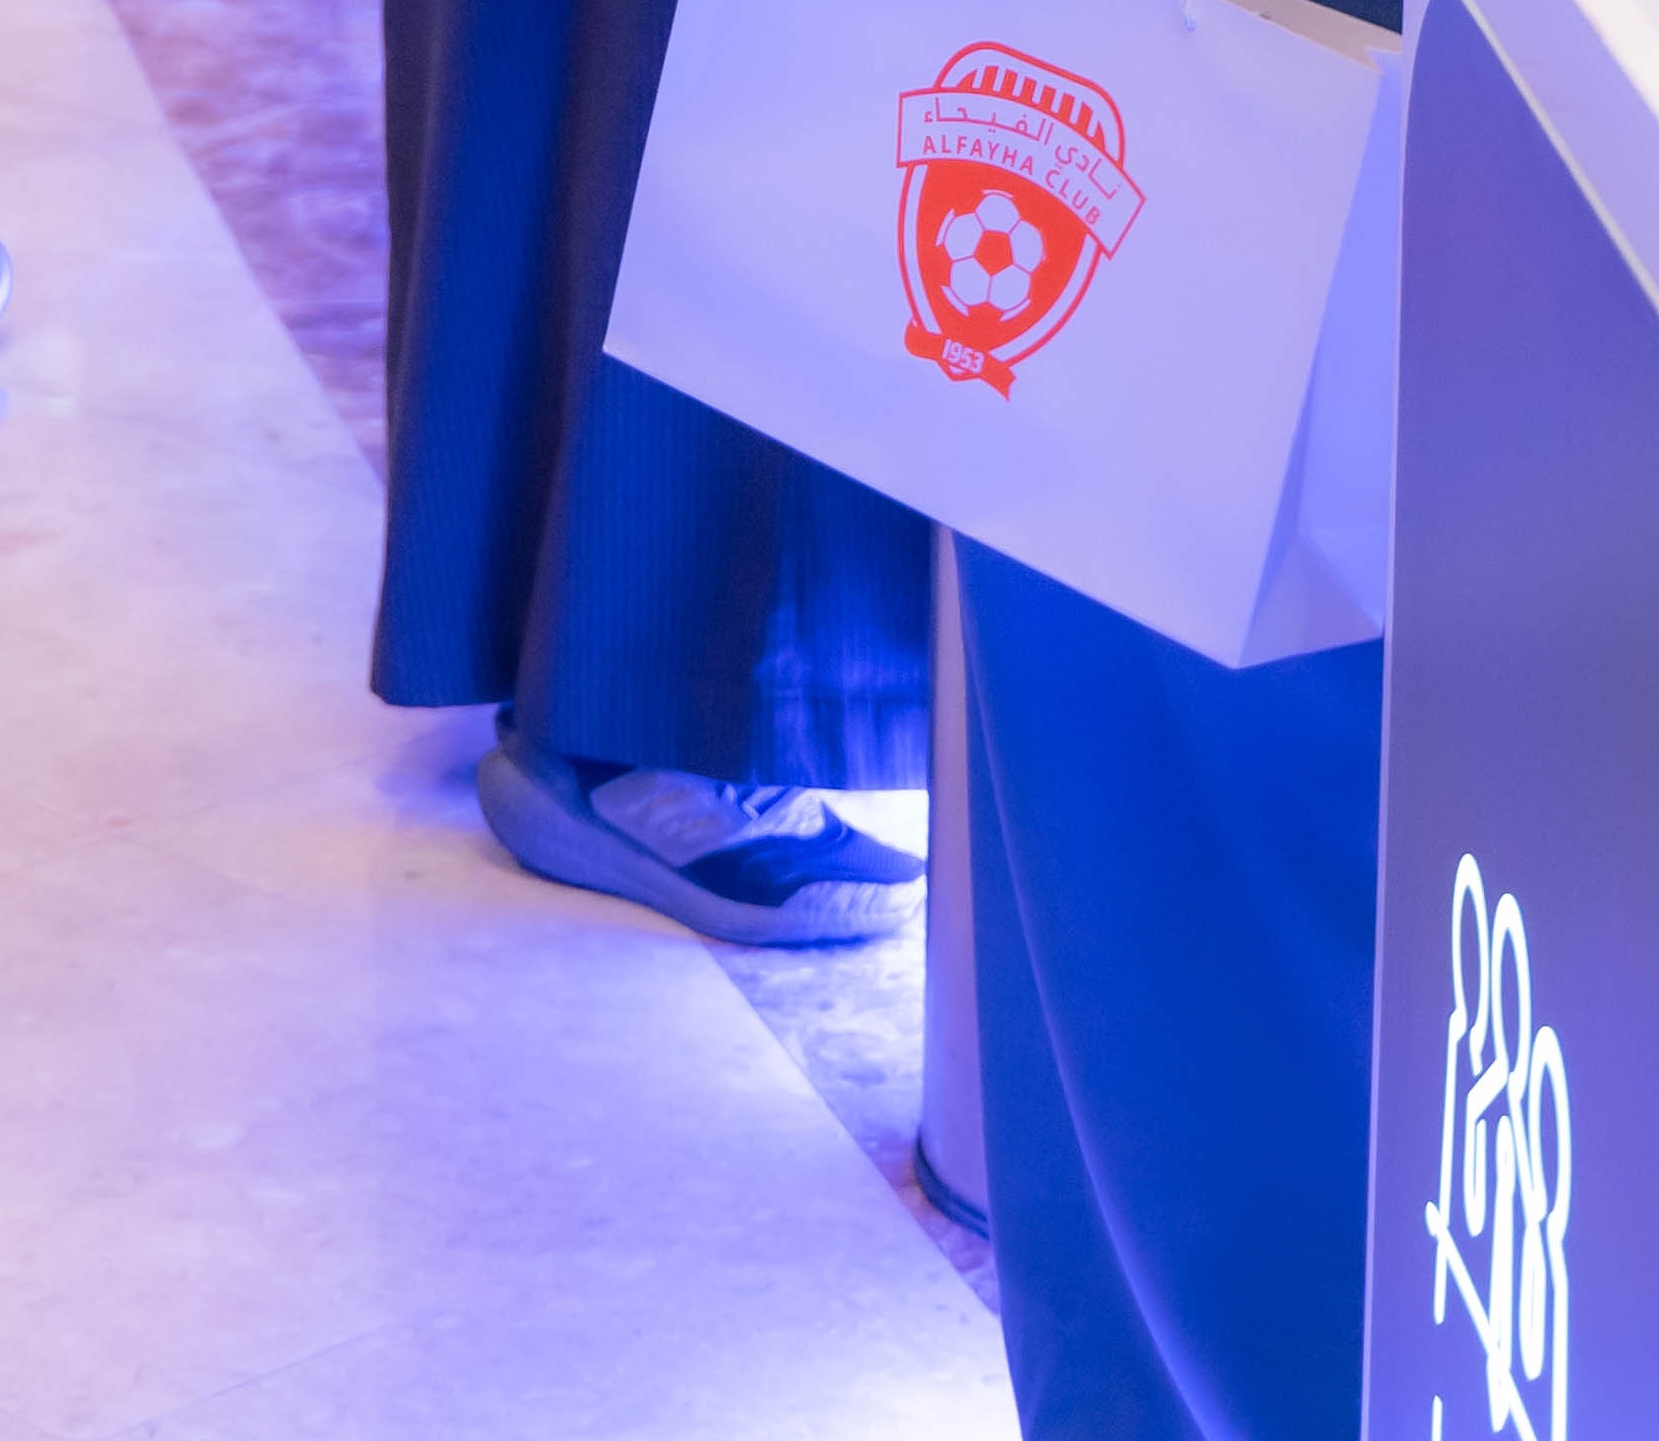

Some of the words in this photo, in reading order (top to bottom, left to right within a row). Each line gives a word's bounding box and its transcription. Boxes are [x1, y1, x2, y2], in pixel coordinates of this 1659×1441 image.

[923, 96, 1055, 146] الفيحاء
[923, 134, 1034, 176] ALFAYHA
[1044, 168, 1102, 226] CLUB
[1054, 144, 1122, 200] نادي
[942, 338, 985, 374] 1953
